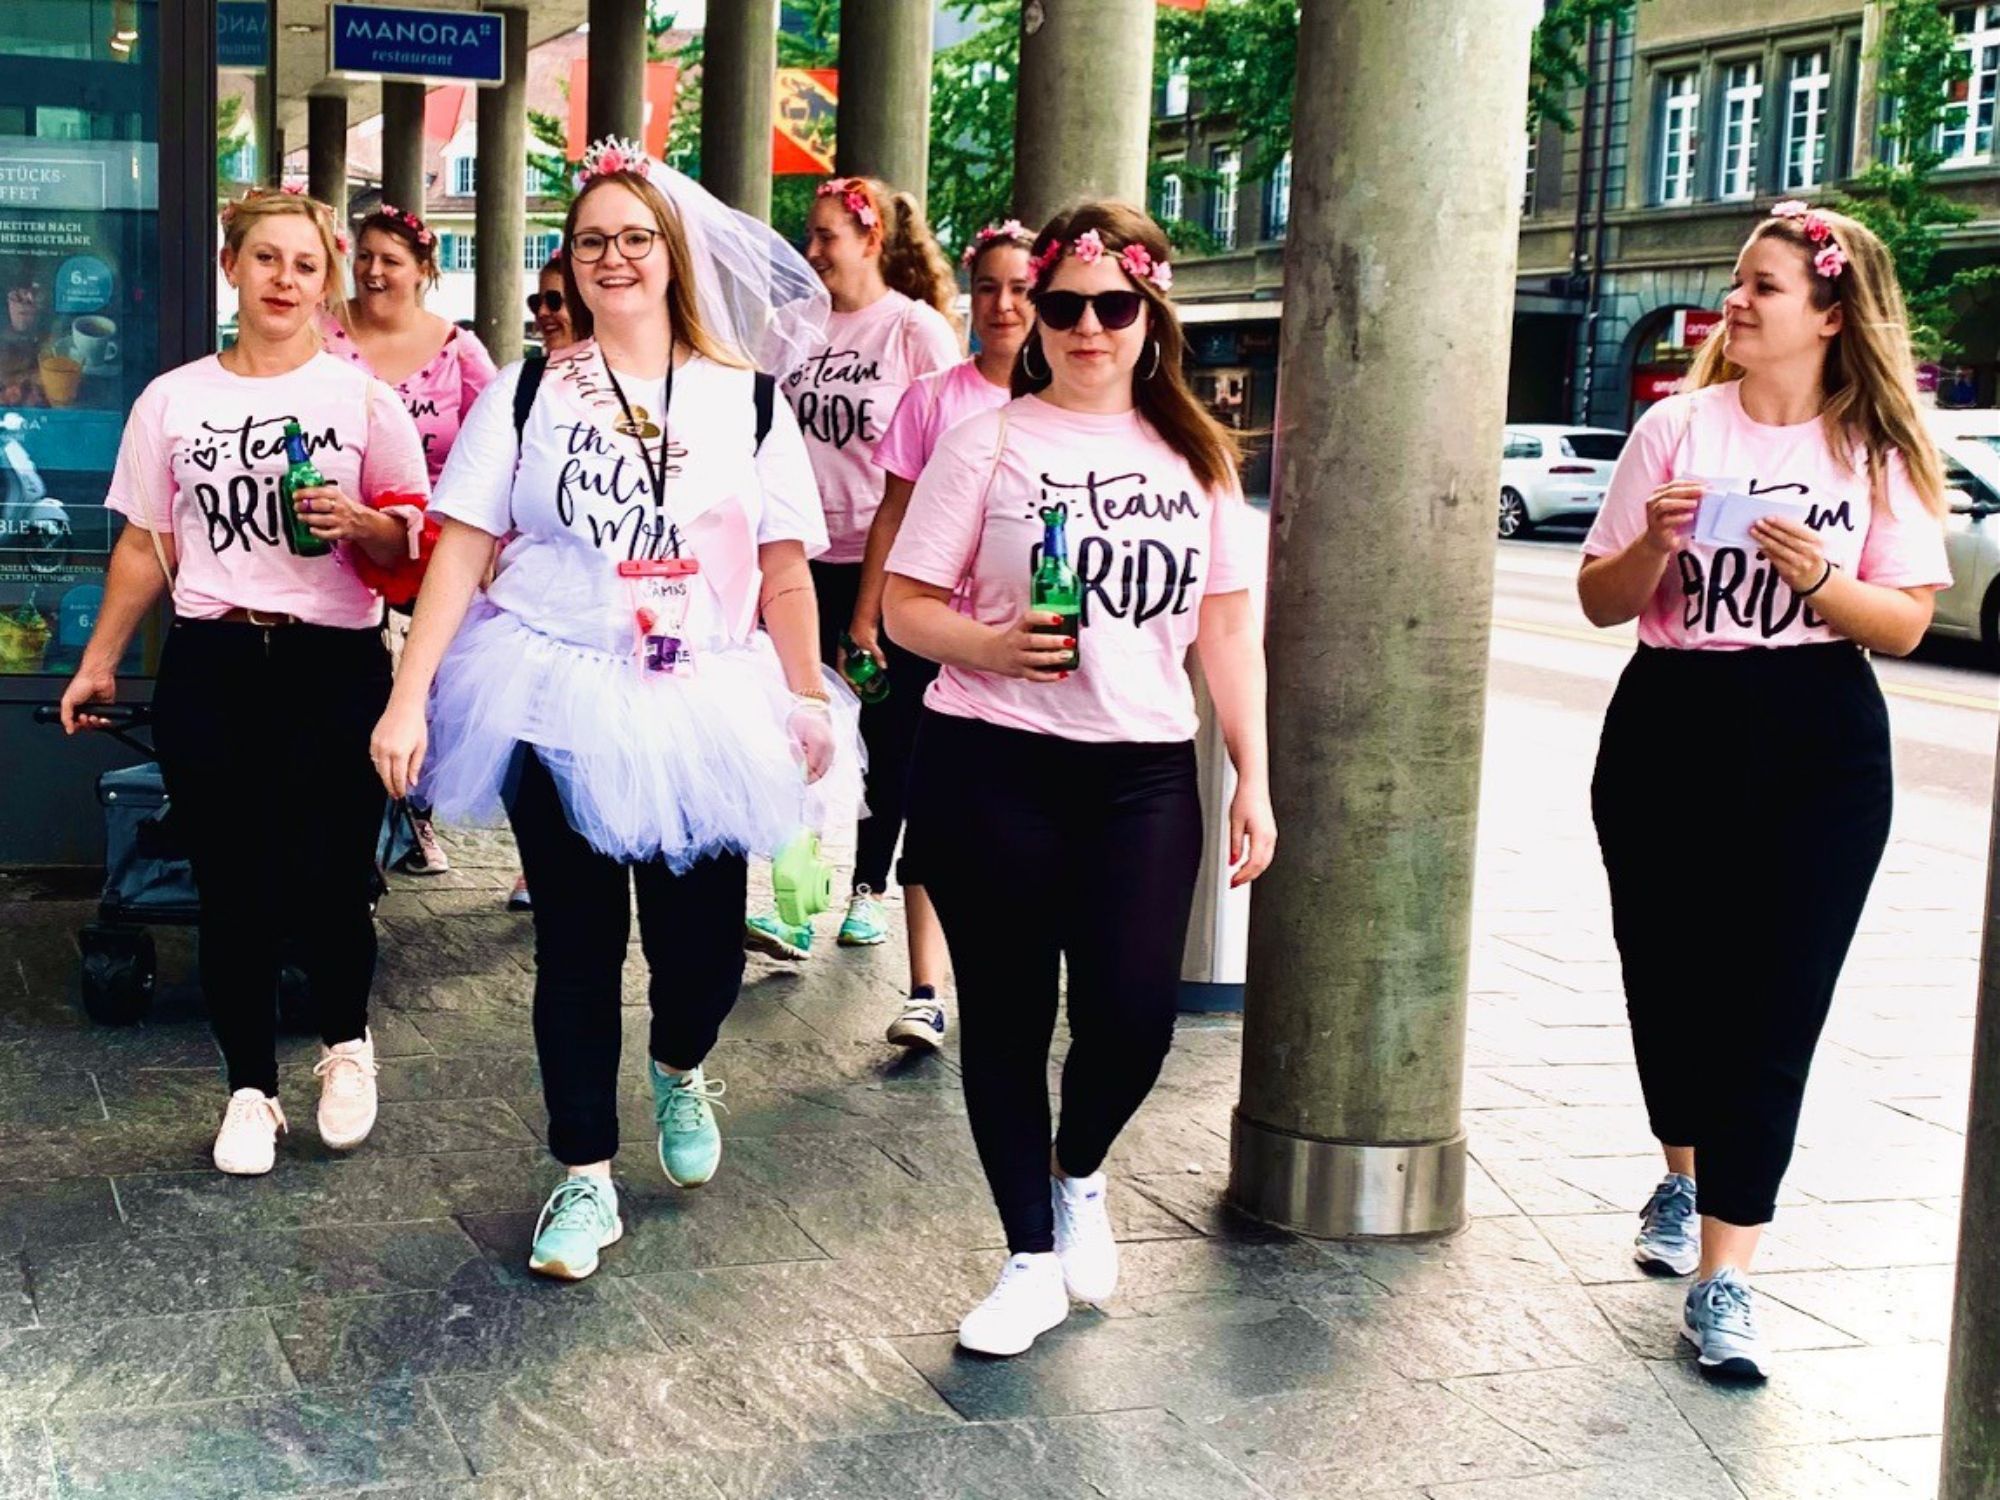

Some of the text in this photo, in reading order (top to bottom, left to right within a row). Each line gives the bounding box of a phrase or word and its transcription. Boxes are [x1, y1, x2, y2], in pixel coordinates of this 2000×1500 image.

[346, 19, 480, 47] MANORA
[372, 50, 453, 65] restaurant
[0, 221, 81, 233] KEITEN NACH
[808, 346, 881, 388] team
[786, 391, 875, 449] RiDE
[554, 421, 617, 455] th
[1041, 471, 1199, 530] team
